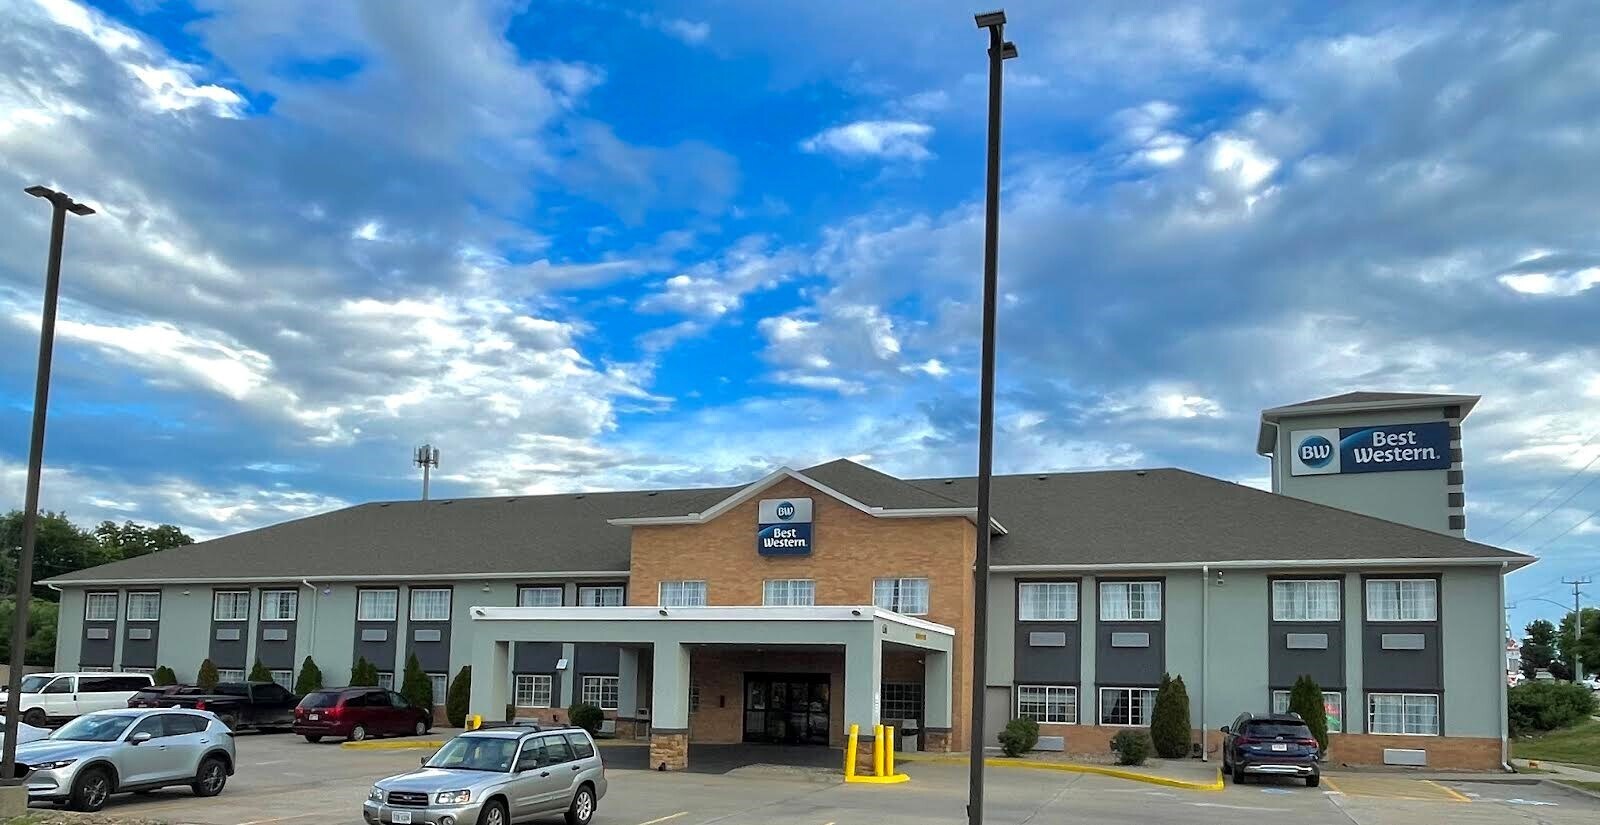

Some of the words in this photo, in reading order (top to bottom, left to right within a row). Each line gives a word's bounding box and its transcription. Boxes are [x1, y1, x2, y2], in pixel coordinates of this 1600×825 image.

[1372, 431, 1416, 446] Best
[1301, 444, 1330, 460] BW
[778, 507, 794, 516] BW
[773, 528, 797, 538] Best
